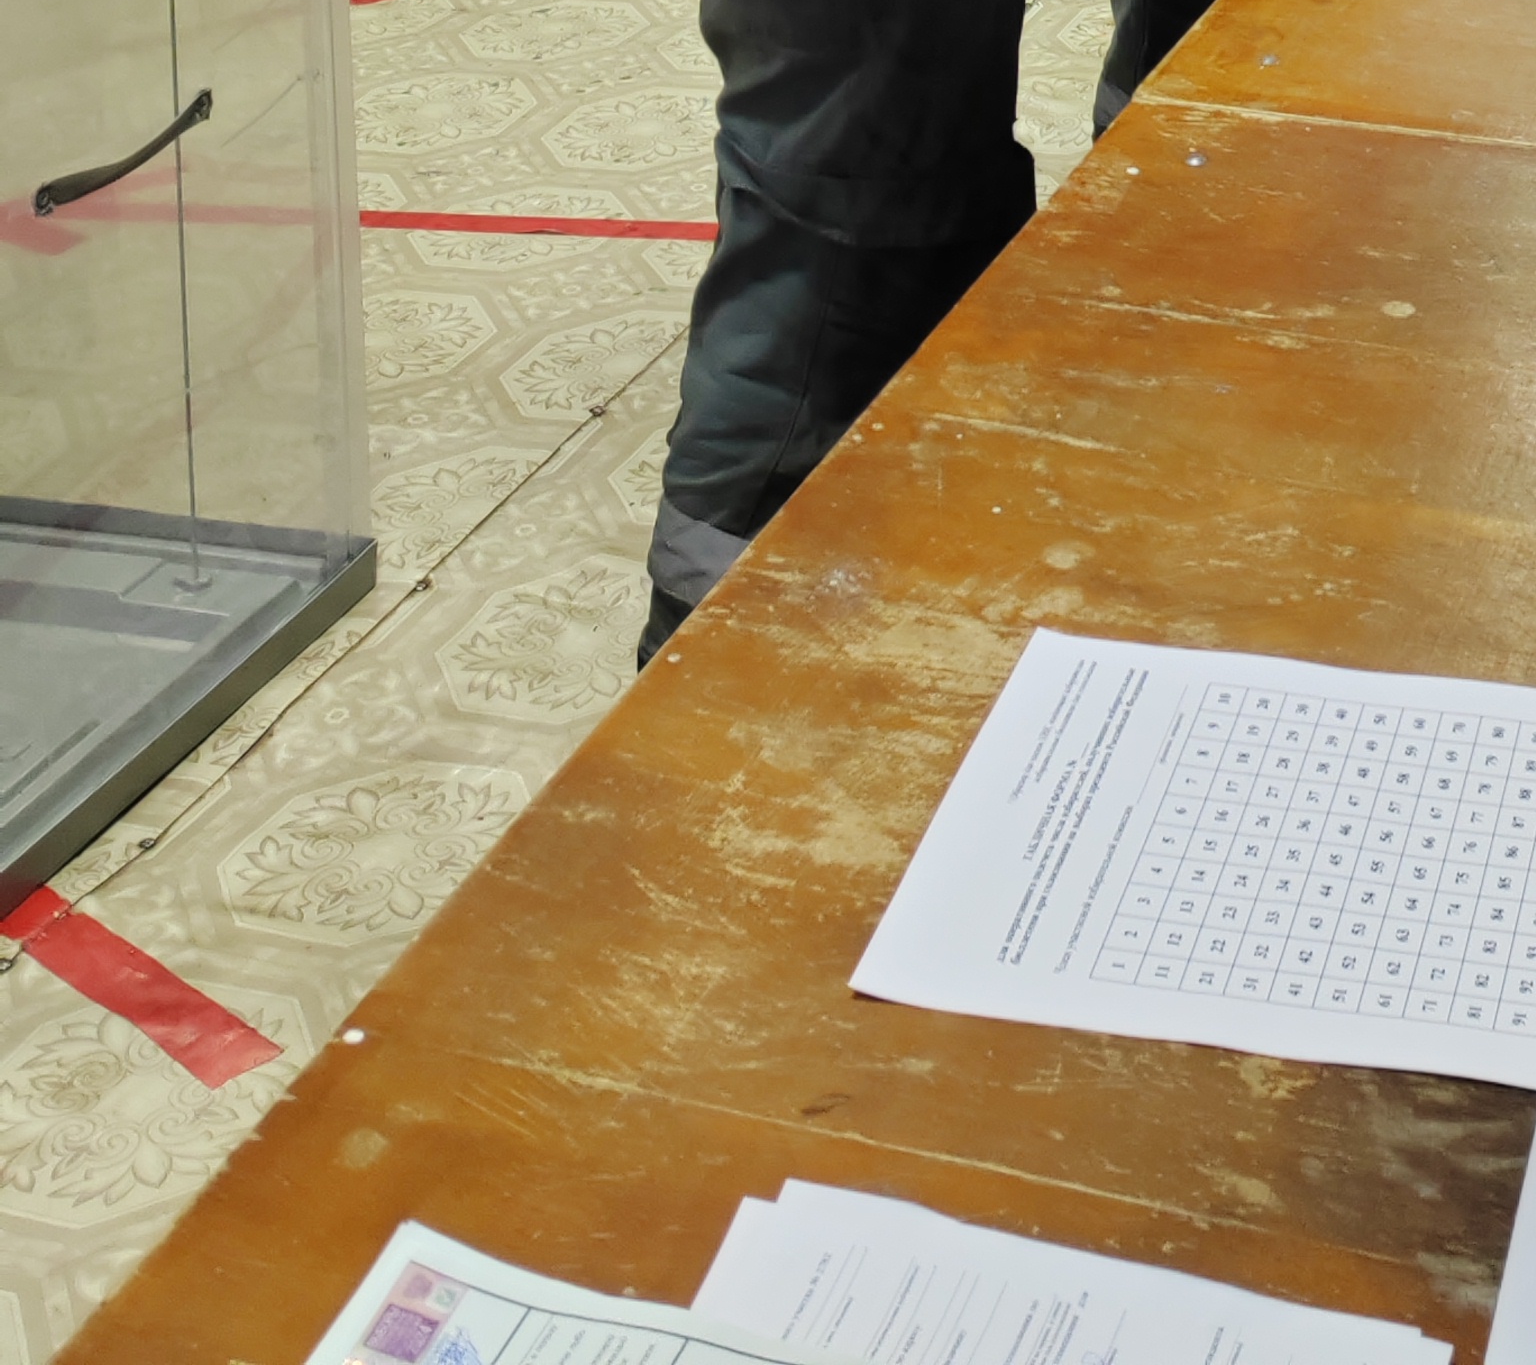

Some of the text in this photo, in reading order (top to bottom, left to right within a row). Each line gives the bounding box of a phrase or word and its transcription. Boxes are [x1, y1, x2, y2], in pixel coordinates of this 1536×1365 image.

[1022, 803, 1058, 861] ТАБЛИЧНАЯ
[1050, 770, 1074, 804] ФОРМА
[1154, 779, 1238, 979] 11 12 13 14 15 16 17
[1198, 785, 1279, 986] 21 22 23 24 25 26 27
[1242, 790, 1320, 992] 31 32 33 34 35 36 37
[1288, 794, 1359, 996] 41 42 43 44 45 46 47
[1332, 800, 1401, 1002] 51 52 53 54 55 56 57
[1377, 806, 1442, 1008] 61 62 63 64 65 66 67
[1422, 841, 1478, 1012] 71 72 73 74 75 76
[1467, 816, 1525, 1020] 81 82 83 84 85 86 87
[1519, 979, 1534, 994] 92
[1512, 1012, 1527, 1026] 91
